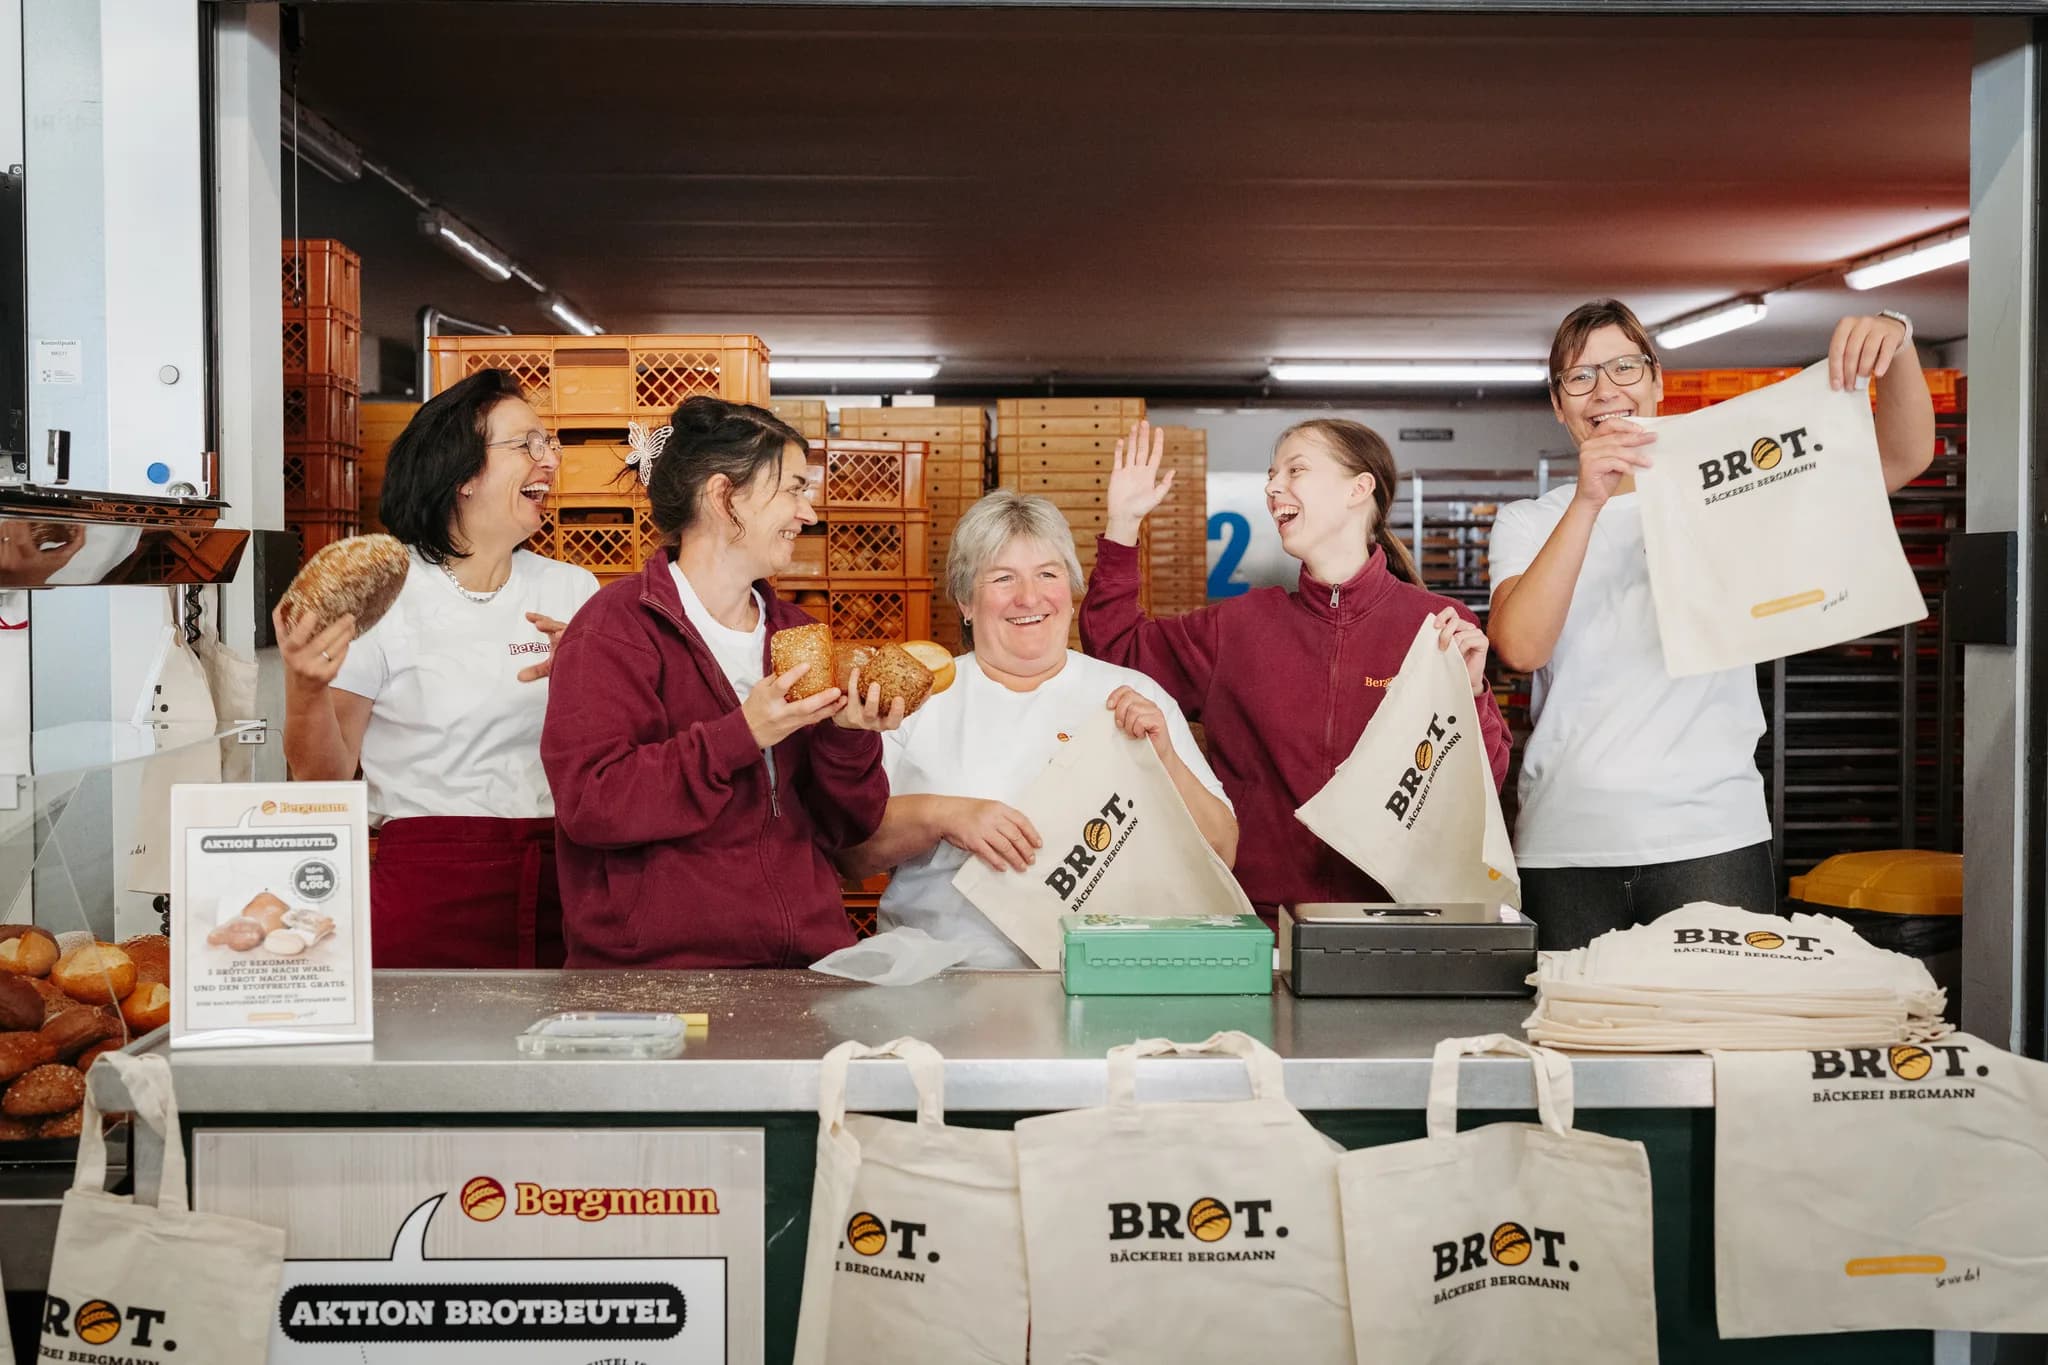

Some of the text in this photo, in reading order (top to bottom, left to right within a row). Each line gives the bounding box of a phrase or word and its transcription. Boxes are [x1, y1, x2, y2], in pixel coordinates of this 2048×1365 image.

[1699, 427, 1823, 490] BROT.
[1704, 461, 1817, 505] BÄCKEREI BERGMANN
[1207, 511, 1250, 598] 2
[1385, 712, 1456, 822] BROT.
[1405, 732, 1462, 831] BÄCKEREI BERGMANN
[279, 802, 348, 815] Bergmann
[203, 837, 335, 849] AKTION BROTBEUTEL
[1045, 792, 1134, 901] BROT.
[1072, 817, 1139, 912] BÄCKEREI BERGMANN
[1674, 928, 1835, 955] BROT.
[1674, 947, 1739, 956] BÄCKEREI
[193, 984, 216, 992] UND
[242, 982, 307, 990] STOFFBEUTEL
[1808, 1045, 1989, 1080] BROT.
[1813, 1088, 1976, 1102] BÄCKEREI BERGMANN
[515, 1182, 719, 1222] Bergmann
[1108, 1197, 1288, 1242] BROT.
[1110, 1250, 1275, 1263] BÄCKEREI BERGMANN
[1433, 1222, 1579, 1282] BROT.
[845, 1262, 925, 1283] BERGMANN
[1433, 1275, 1570, 1304] BÄCKEREI BERGMANN
[289, 1299, 677, 1328] AKTION BROTBEUTEL
